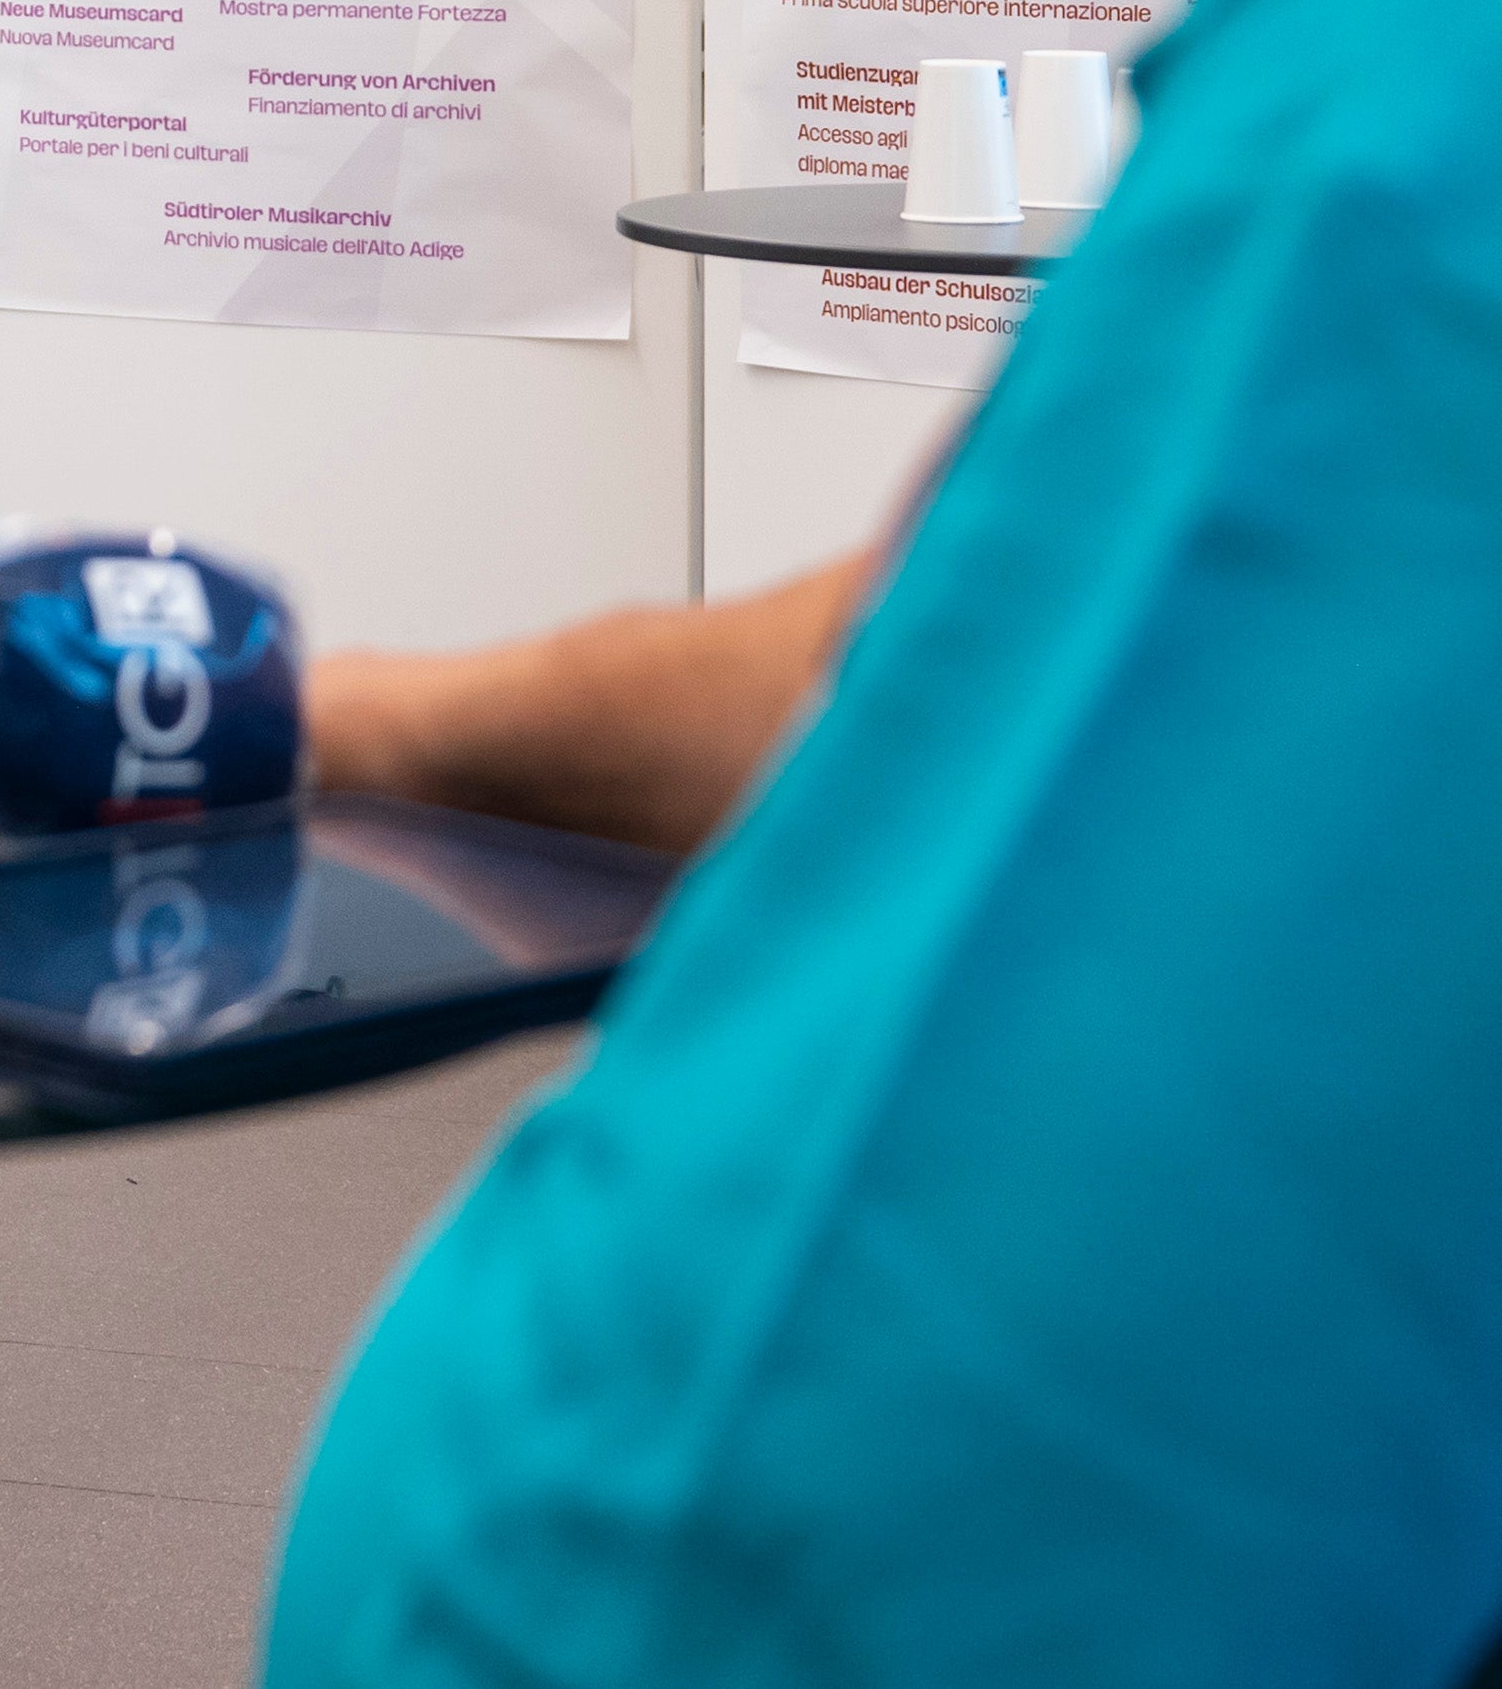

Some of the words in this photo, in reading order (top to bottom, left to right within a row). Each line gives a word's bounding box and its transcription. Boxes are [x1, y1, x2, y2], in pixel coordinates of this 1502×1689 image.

[0, 1, 46, 18] Neue
[48, 3, 184, 23] Museumscard
[219, 0, 289, 18] Mostra
[292, 3, 414, 21] permanente
[417, 4, 508, 23] Fortezza
[0, 28, 54, 47] Nuova
[56, 30, 175, 52] Museumcard
[248, 67, 358, 91] Förderung
[360, 74, 399, 90] von
[401, 73, 497, 93] Archiven
[248, 96, 388, 119] Finanziamento
[390, 100, 409, 120] di
[412, 103, 482, 121] archivi
[797, 92, 829, 111] mit
[20, 109, 188, 132] Kulturgüterportal
[797, 123, 874, 146] Accesso
[876, 129, 908, 151] agli
[797, 154, 868, 178] diploma
[163, 200, 265, 222] Südtiroler
[267, 206, 393, 228] Musikarchiv
[163, 229, 241, 250] Archivio
[243, 234, 329, 254] musicale
[408, 240, 465, 261] Adige
[821, 267, 891, 292] Ausbau
[895, 274, 931, 295] der
[821, 299, 941, 328] Ampliamento
